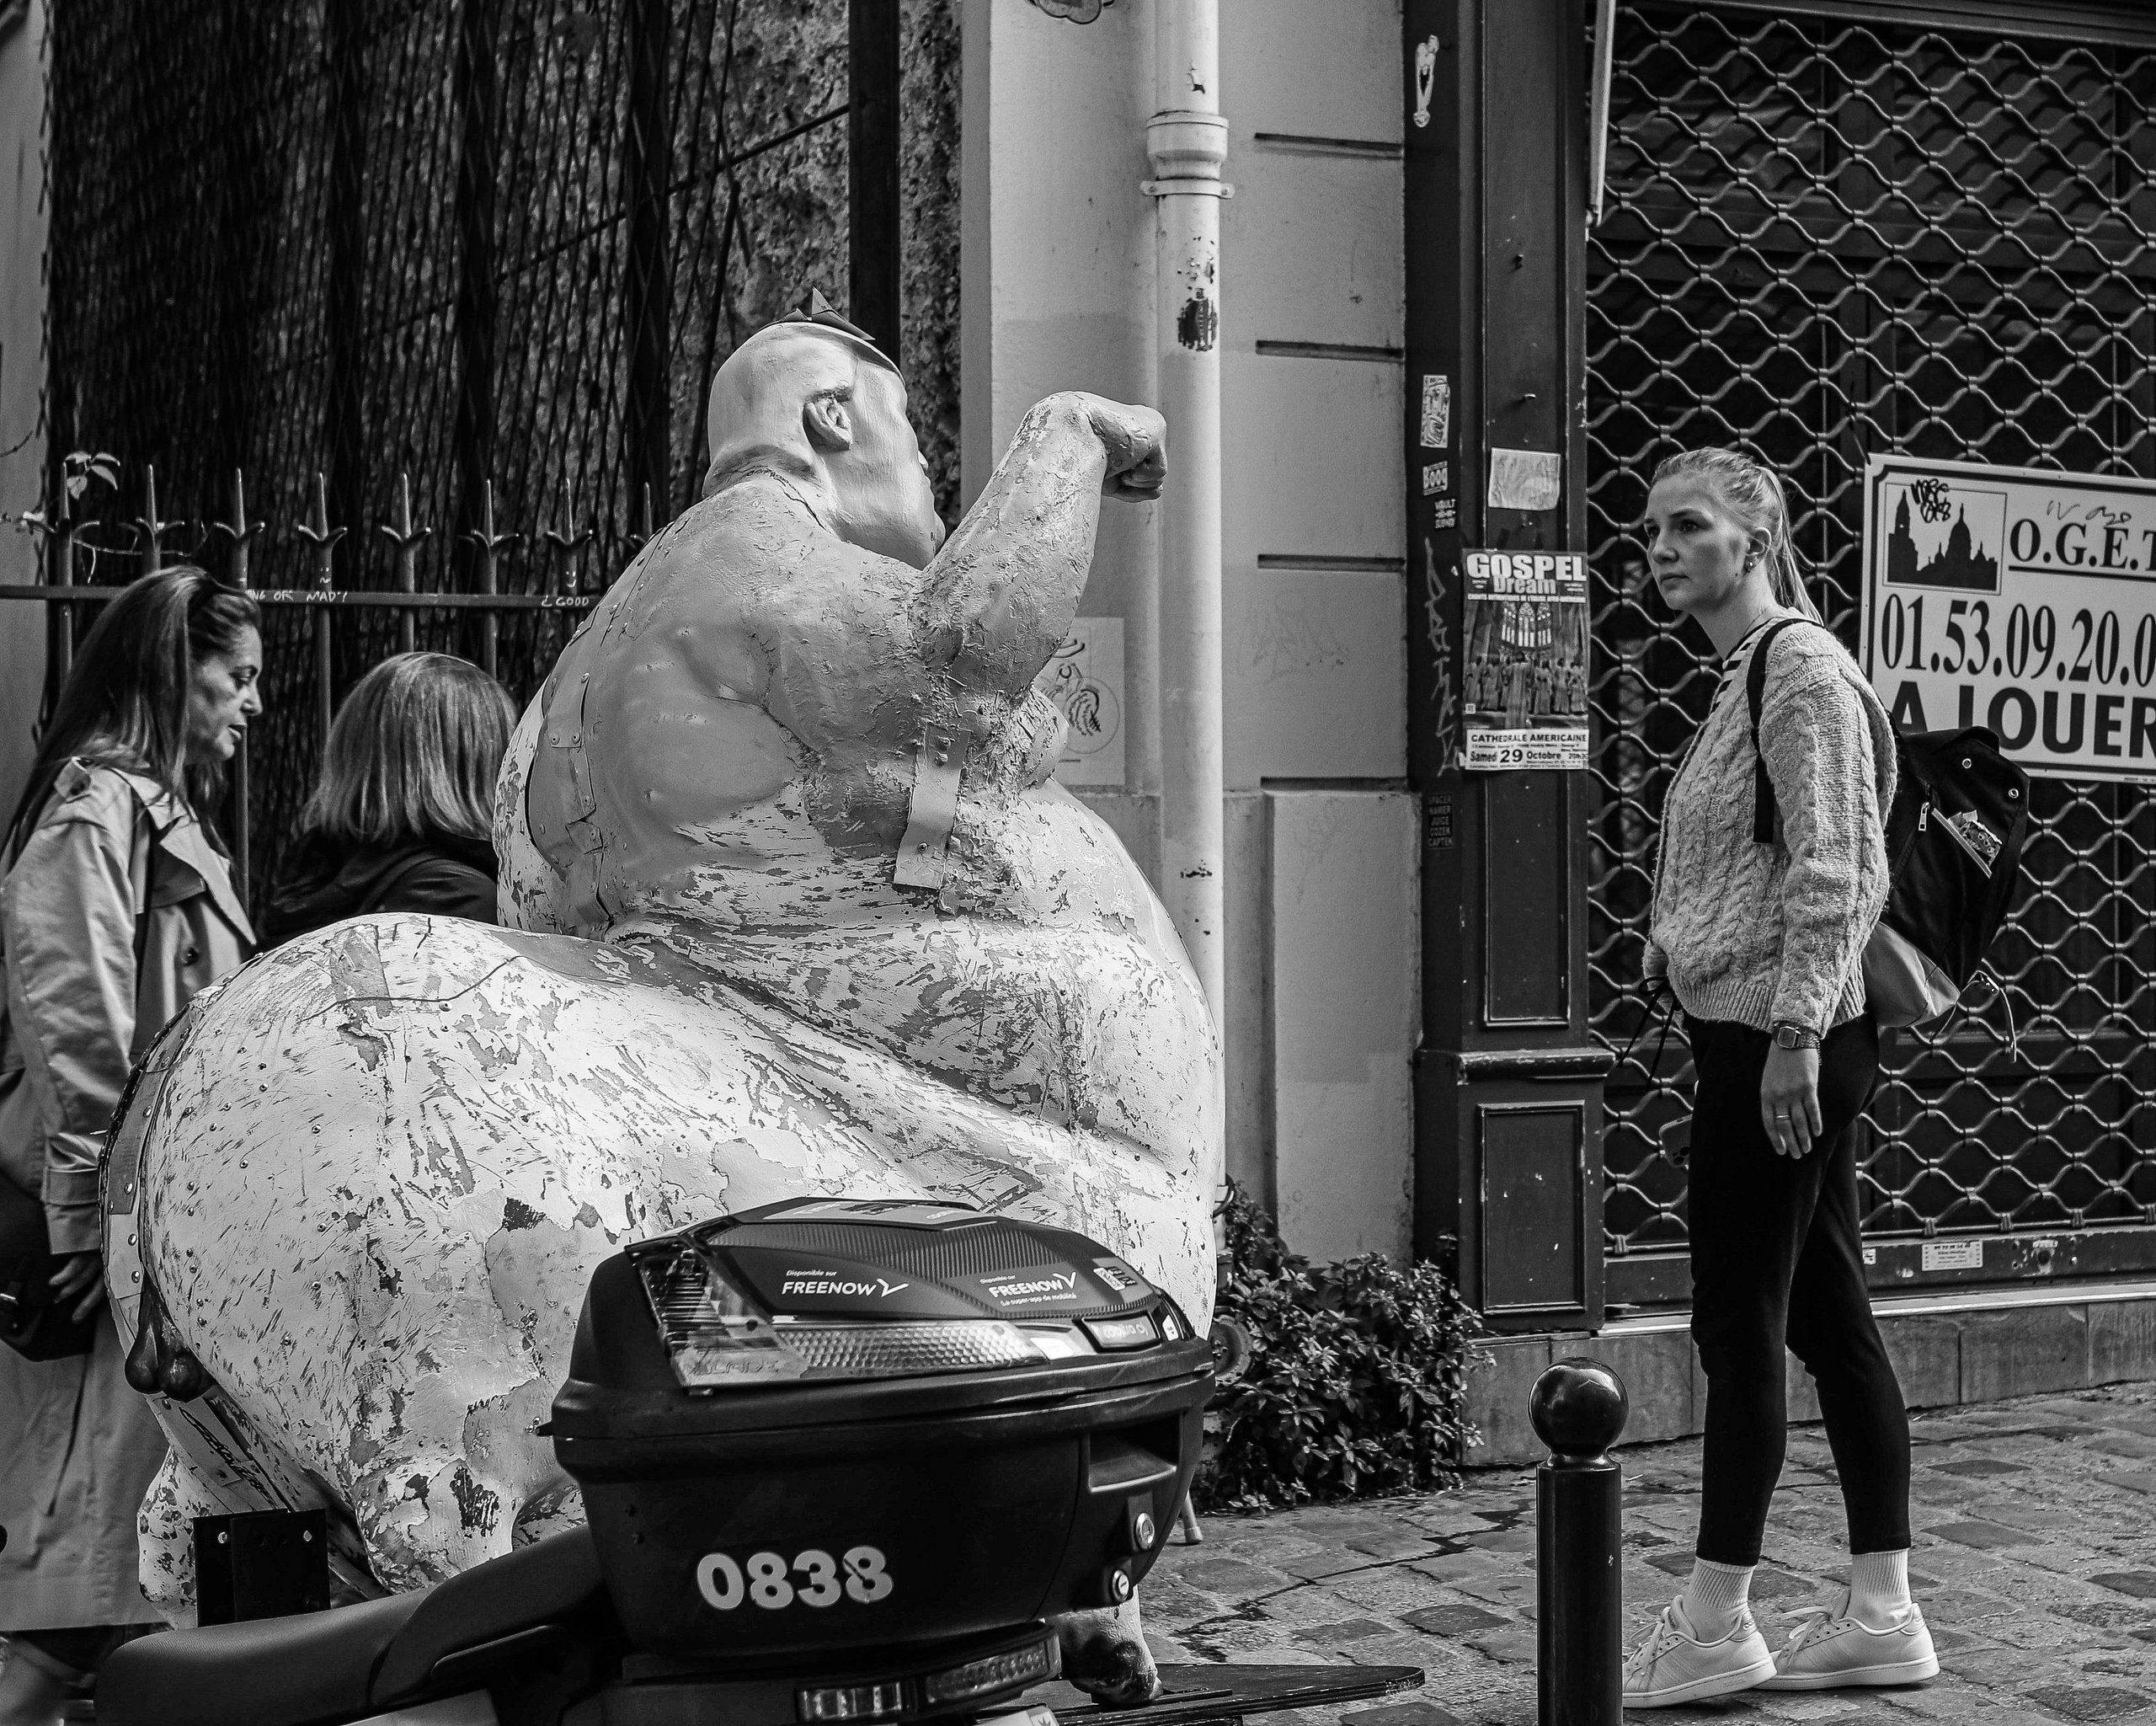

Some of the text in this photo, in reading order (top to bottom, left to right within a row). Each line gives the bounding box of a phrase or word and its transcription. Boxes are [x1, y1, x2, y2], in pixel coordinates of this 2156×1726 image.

[1466, 553, 1587, 581] GOSPEL
[1492, 575, 1556, 595] Dream
[1471, 734, 1587, 743] CATHEDRALE AMERICAINE
[1500, 749, 1523, 762] 29
[1527, 751, 1561, 760] Octobre
[782, 1280, 877, 1296] FREENOW
[988, 1279, 1063, 1298] FREENOW
[696, 1545, 894, 1611] 0838
